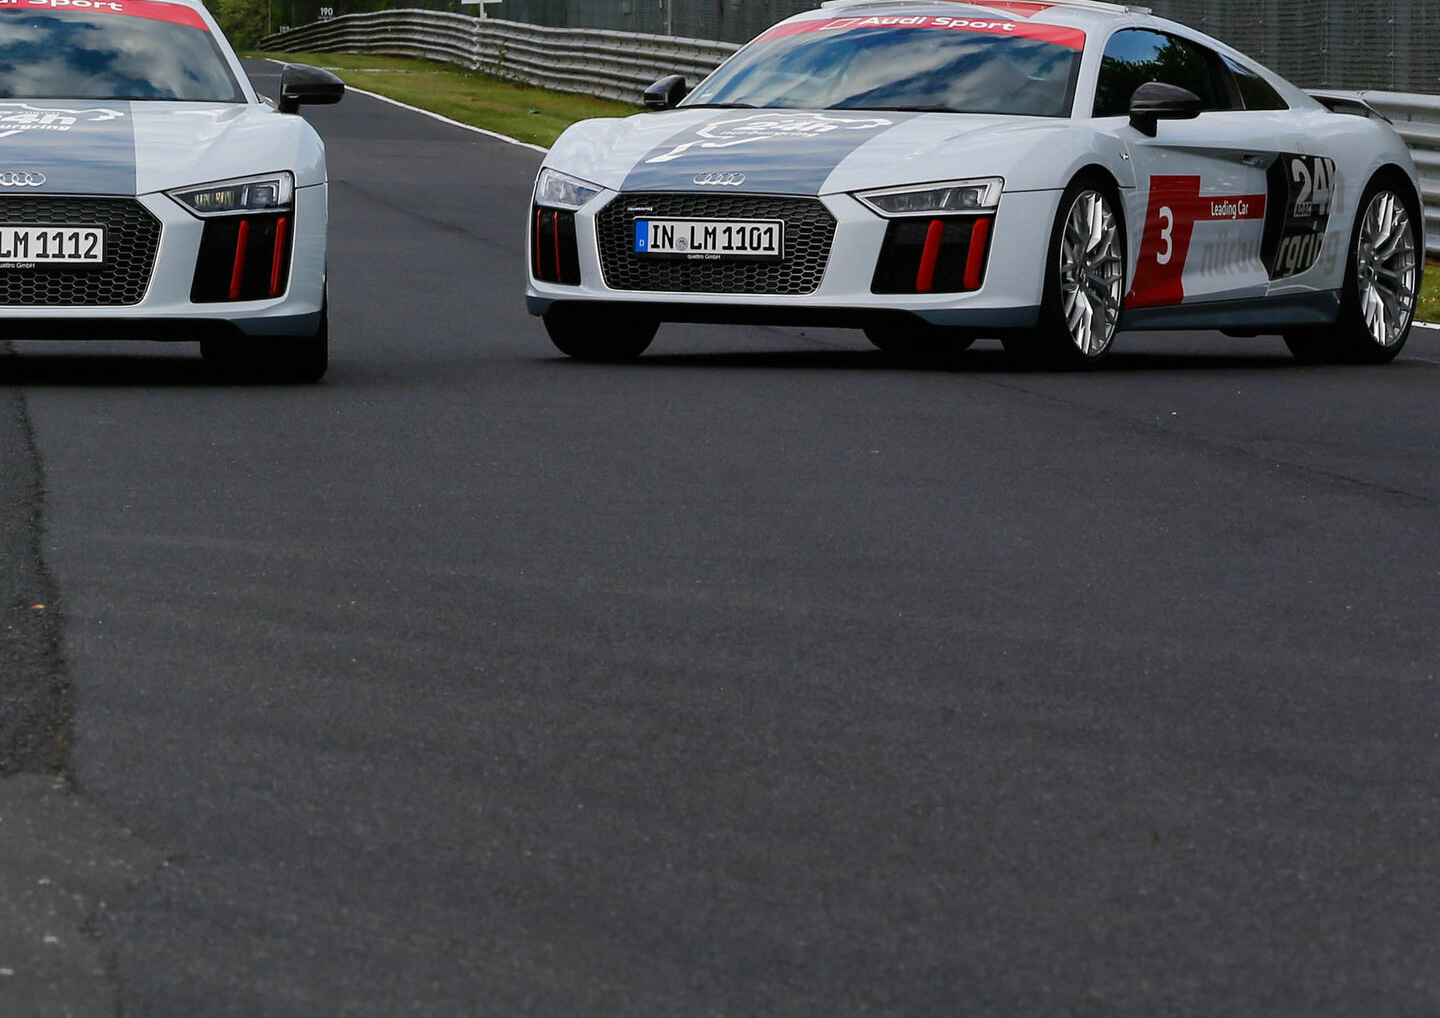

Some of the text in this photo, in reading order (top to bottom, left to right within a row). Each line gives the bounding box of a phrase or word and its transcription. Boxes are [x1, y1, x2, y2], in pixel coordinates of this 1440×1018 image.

[320, 7, 333, 15] 190
[859, 16, 1016, 32] Audi Sport
[1210, 199, 1249, 220] Leading Car
[35, 231, 98, 259] 1112
[638, 239, 645, 247] D
[650, 225, 776, 251] IN LM 1101
[1156, 205, 1174, 265] 3
